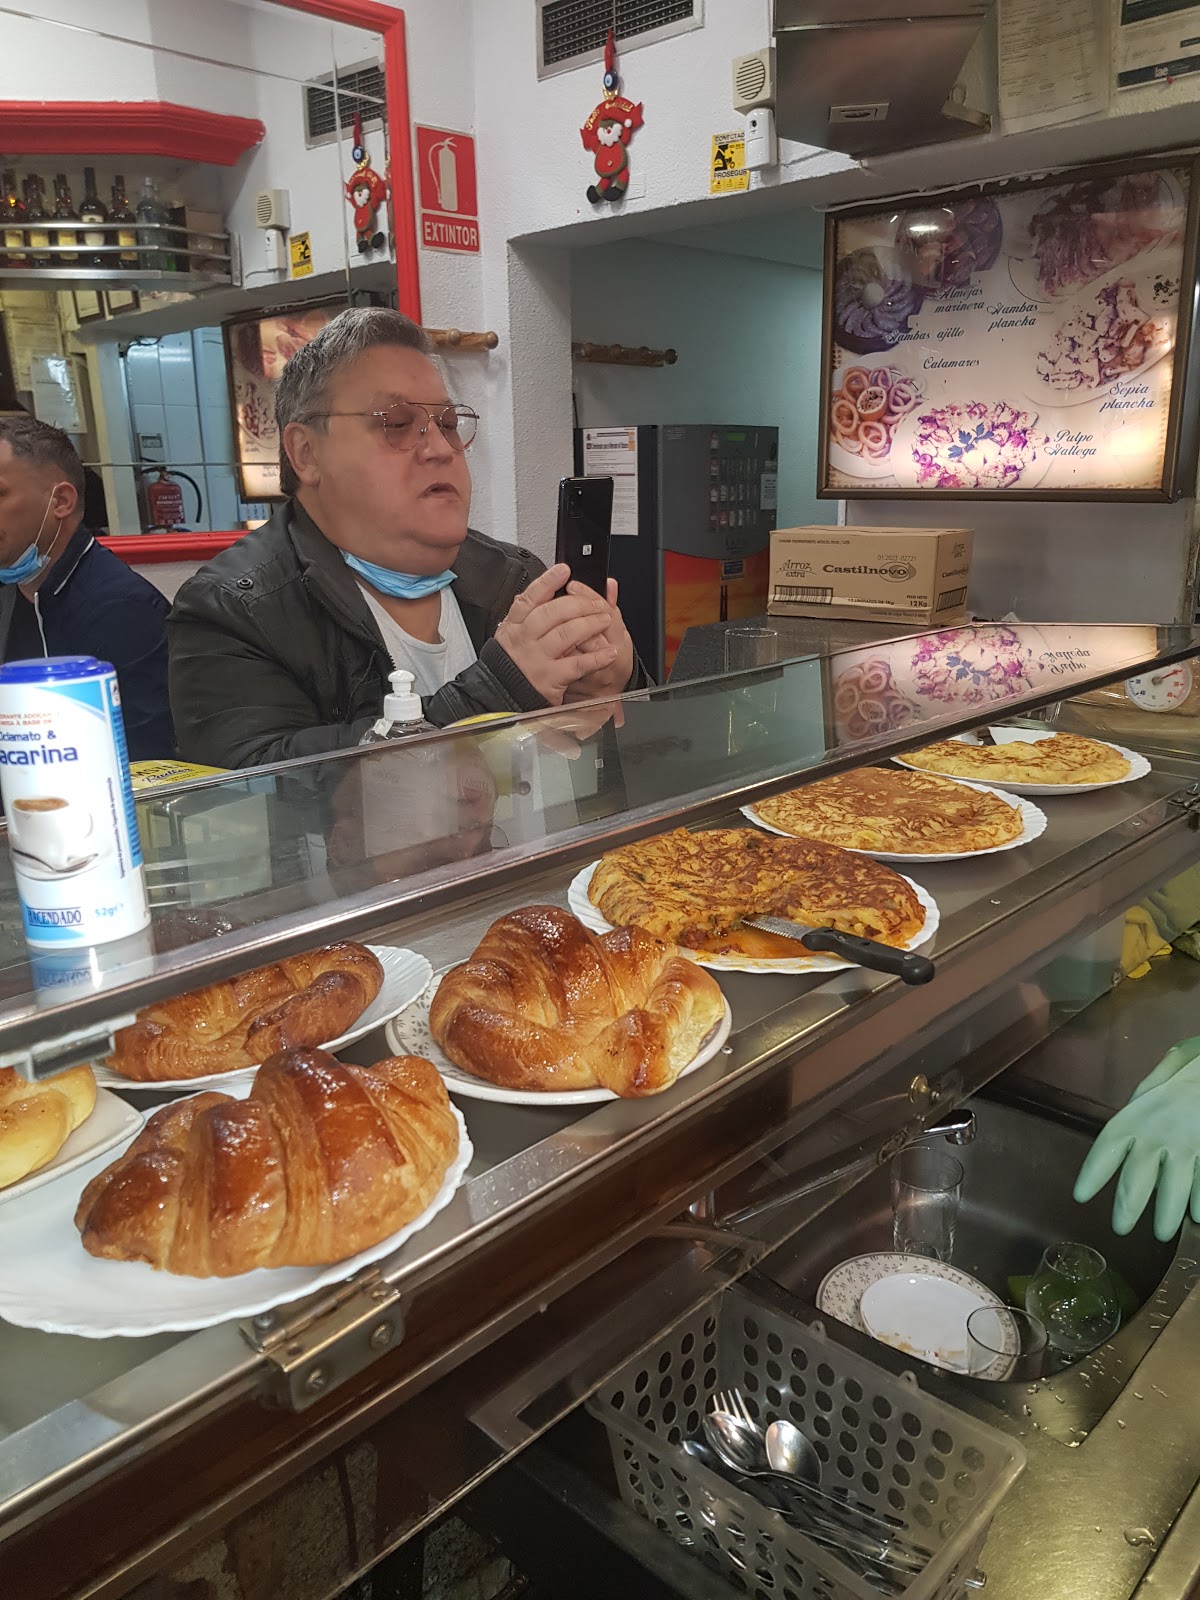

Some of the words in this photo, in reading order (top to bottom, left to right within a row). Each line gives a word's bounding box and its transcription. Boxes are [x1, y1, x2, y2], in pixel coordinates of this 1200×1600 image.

[715, 132, 746, 143] CONECTAD
[714, 168, 748, 180] PROSEGUR
[424, 221, 478, 247] EXTINTOR
[937, 286, 983, 300] Almejas
[934, 301, 985, 314] marinera
[987, 316, 1037, 332] plancha
[936, 327, 965, 342] ajillo
[923, 356, 980, 370] Calamares
[1109, 381, 1150, 398] Sepia
[1099, 397, 1156, 413] plancha
[1054, 429, 1094, 444] Pulpo
[782, 559, 813, 571] Arroz
[822, 564, 908, 577] Castilnovo
[785, 570, 806, 578] extra
[47, 729, 57, 740] &
[27, 909, 82, 926] HACENDADO
